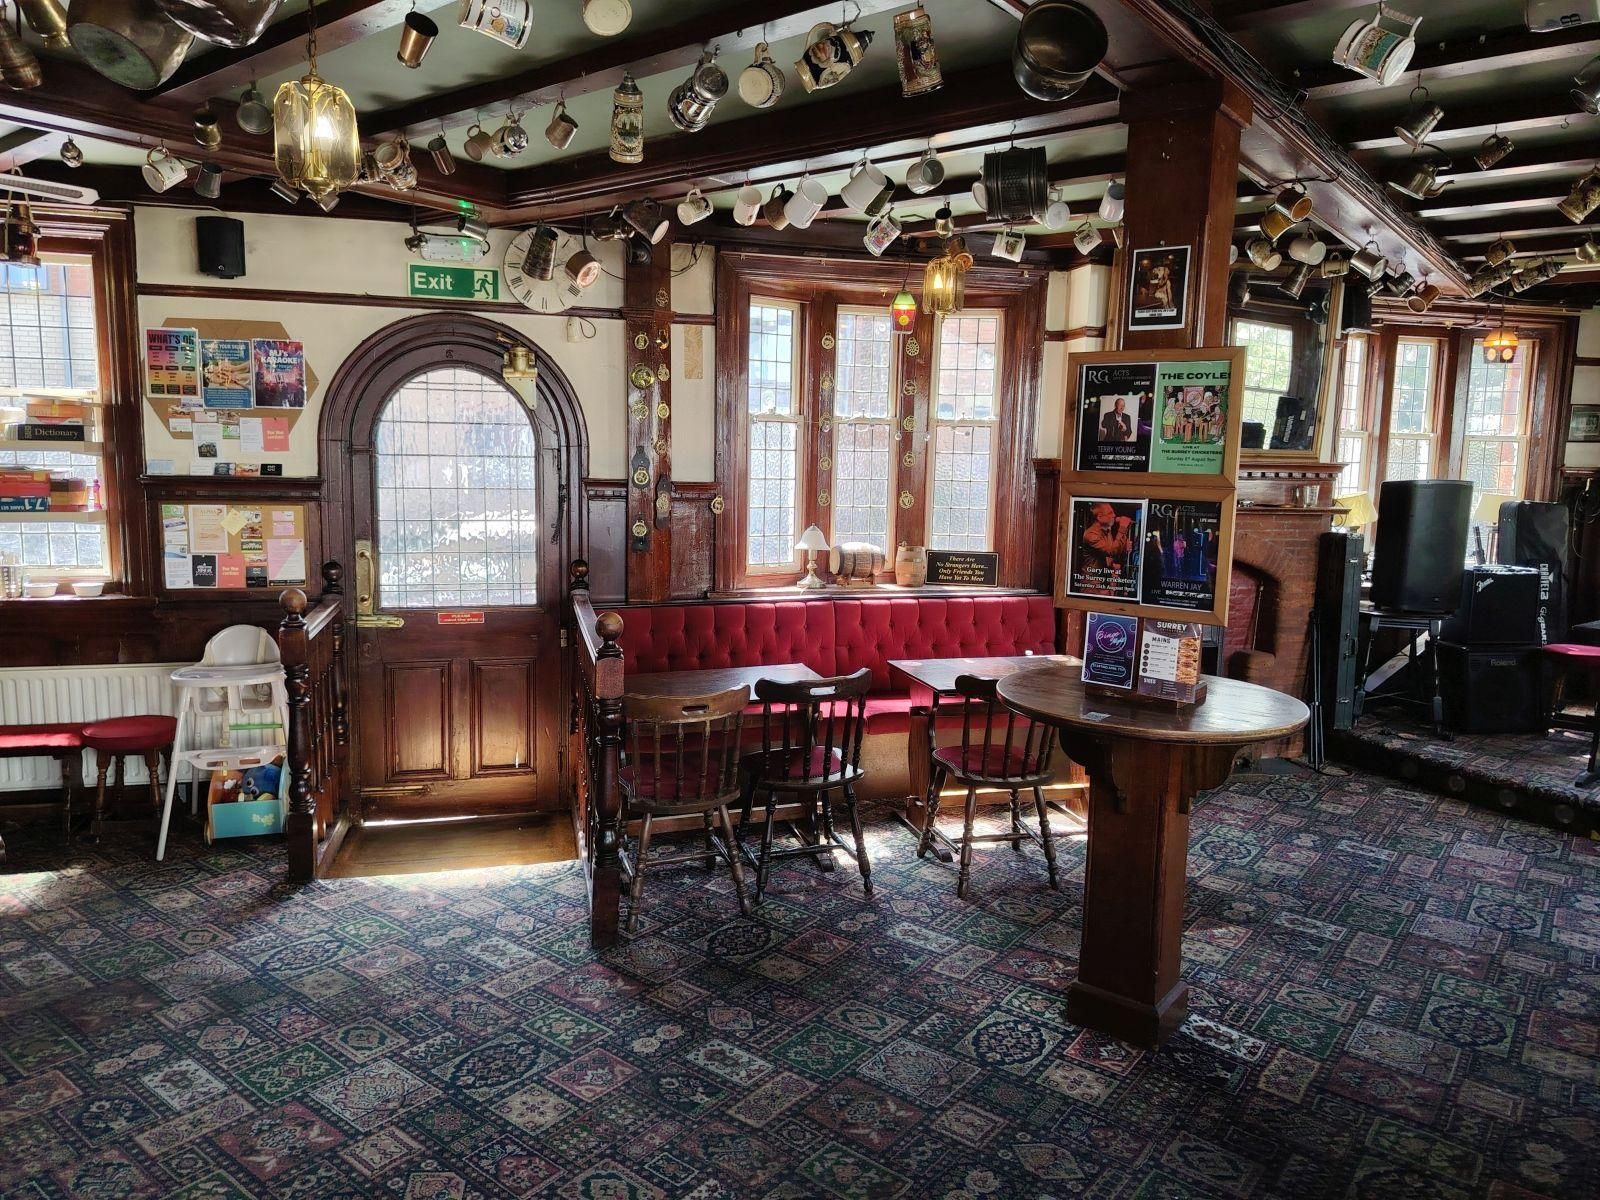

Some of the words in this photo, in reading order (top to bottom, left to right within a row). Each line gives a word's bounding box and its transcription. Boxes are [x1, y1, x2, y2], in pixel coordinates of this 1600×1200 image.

[414, 272, 453, 290] Exit
[148, 333, 181, 345] WHAT'S
[261, 356, 298, 364] KARAOKE
[1088, 369, 1112, 384] RG
[1160, 372, 1185, 380] THE
[35, 428, 79, 440] Dictionary
[1097, 445, 1114, 453] TERRY
[1115, 446, 1137, 454] YOUNG
[1151, 503, 1176, 518] RG
[944, 561, 970, 569] Strangers
[1086, 566, 1103, 574] Gary
[1085, 574, 1106, 583] Surrey
[1106, 576, 1137, 584] cricketers
[1161, 581, 1189, 590] WARREN
[1189, 583, 1202, 591] JAY
[1157, 621, 1188, 631] SURREY
[1097, 631, 1121, 641] Bingo
[1151, 636, 1171, 644] MAINS
[1490, 658, 1517, 666] Roland
